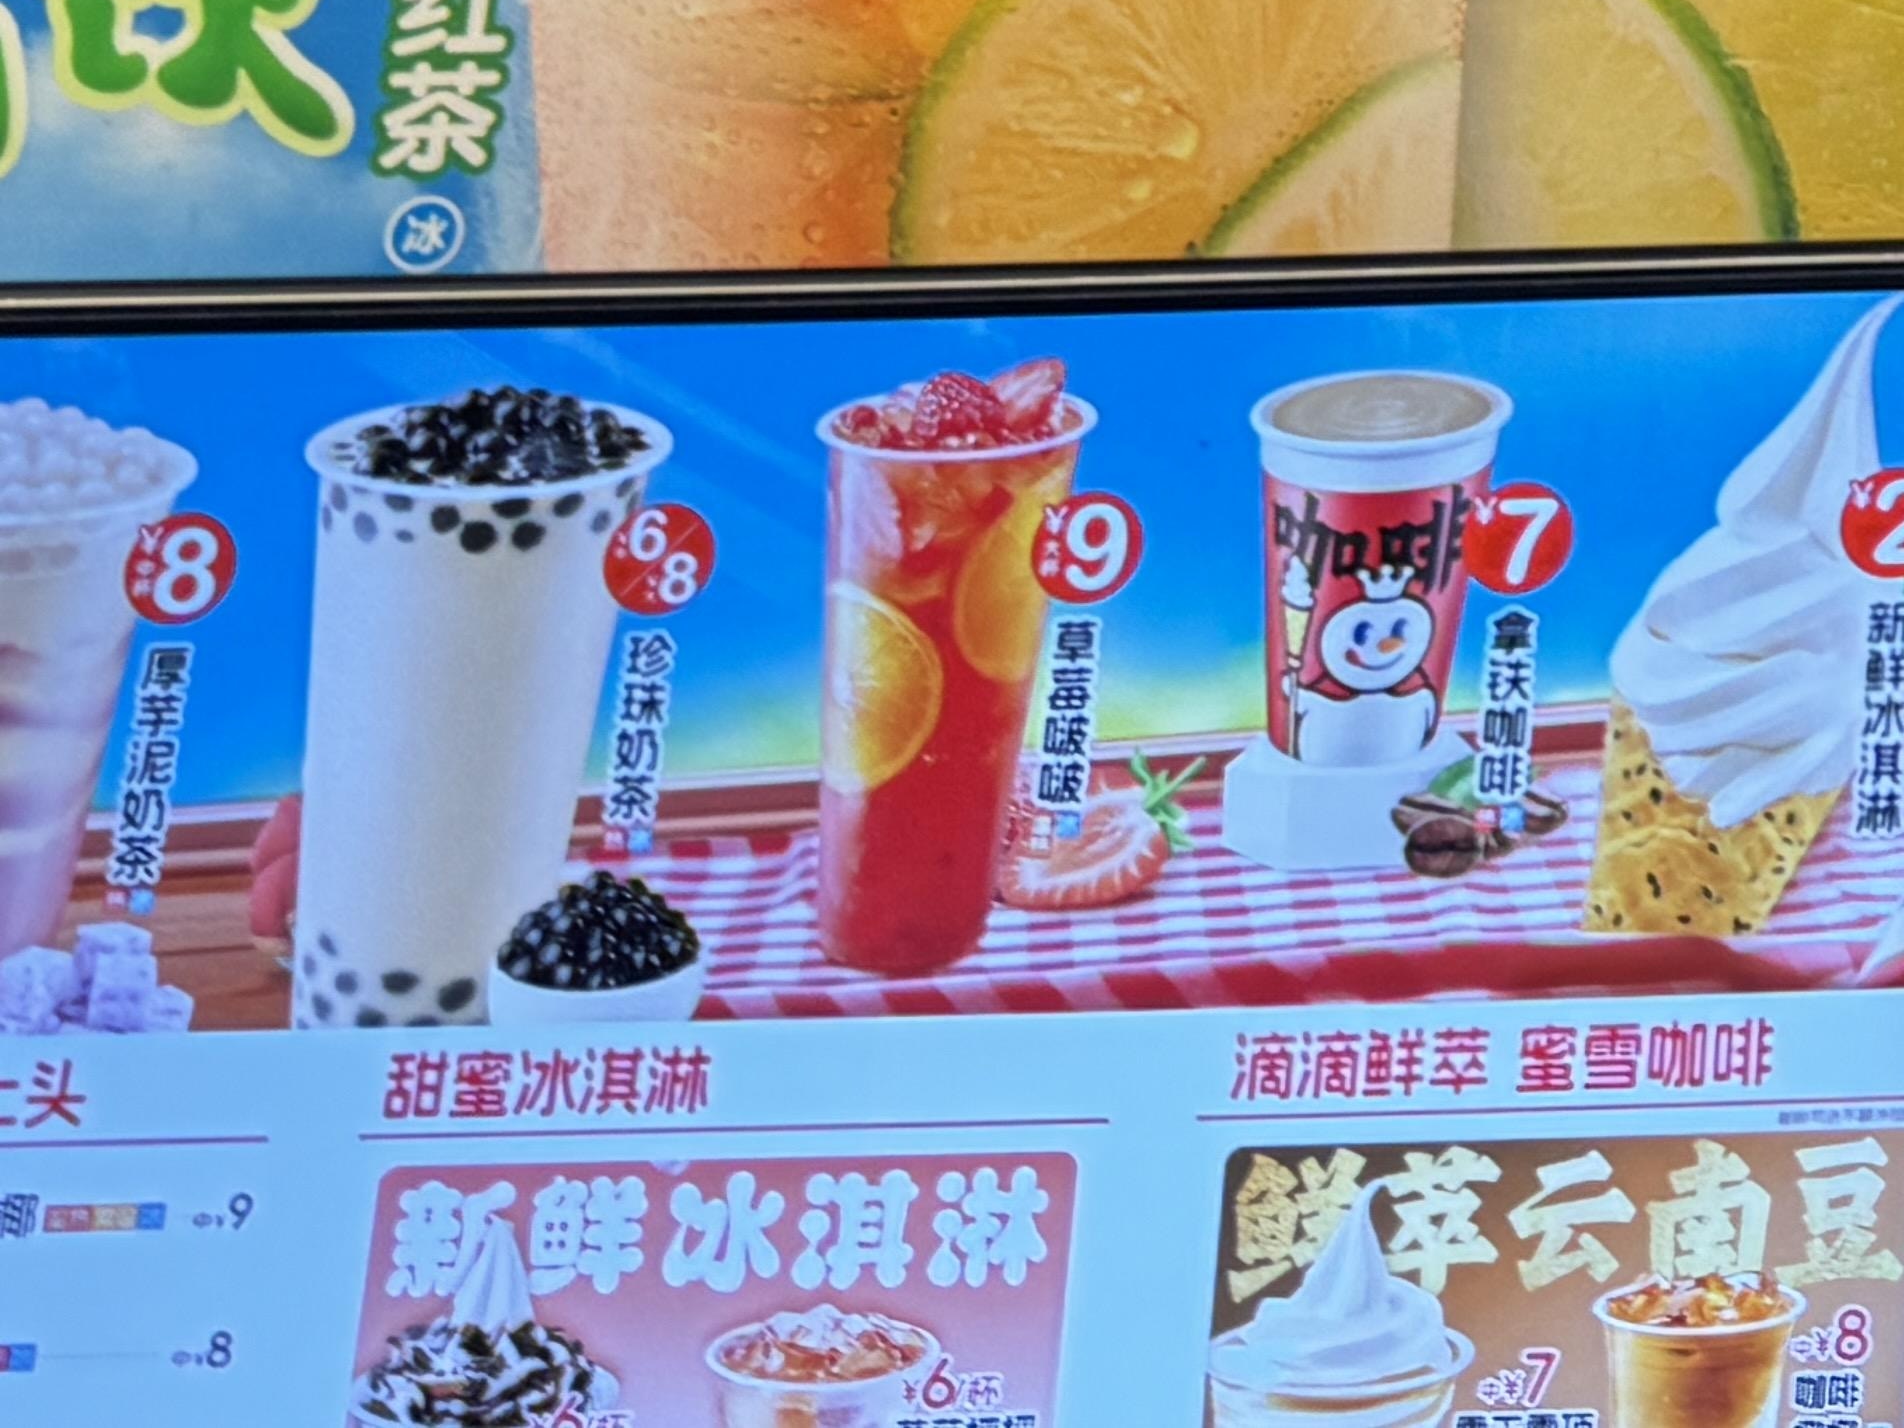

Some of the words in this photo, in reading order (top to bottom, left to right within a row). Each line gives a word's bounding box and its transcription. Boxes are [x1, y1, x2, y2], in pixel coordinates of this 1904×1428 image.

[402, 214, 448, 256] 冰
[114, 647, 192, 881] 厚芋泥奶茶
[607, 633, 673, 820] 珍珠奶茶
[1477, 610, 1537, 796] 拿铁咖啡
[382, 1045, 712, 1121] 甜蜜冰淇淋
[1231, 1026, 1492, 1102] 滴滴鲜萃
[1515, 1016, 1777, 1094] 蜜雪咖啡
[385, 1165, 1051, 1299] 新鲜冰淇淋
[1227, 1136, 1904, 1304] 鲜萃云南豆
